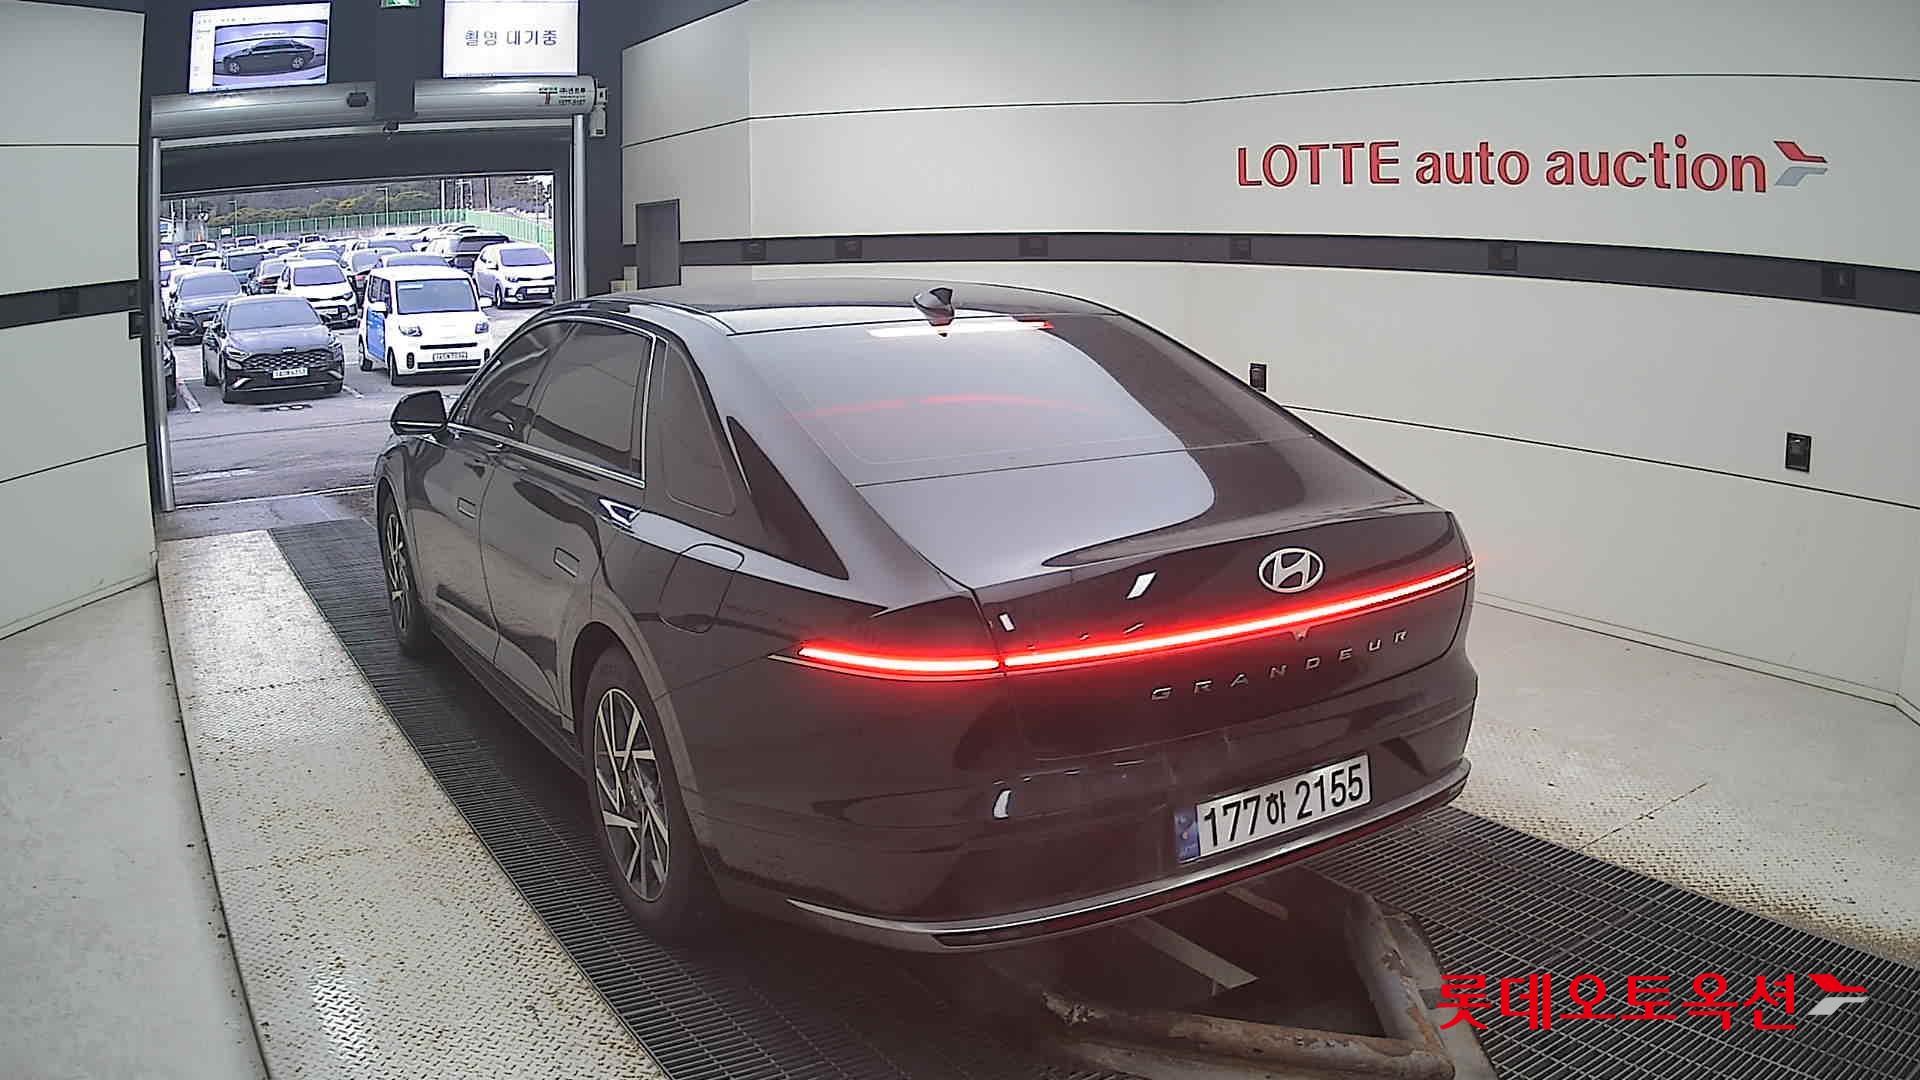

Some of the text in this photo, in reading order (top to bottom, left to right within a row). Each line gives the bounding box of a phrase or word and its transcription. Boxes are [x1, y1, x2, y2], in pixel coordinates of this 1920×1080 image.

[506, 29, 557, 46] 대기중
[1237, 134, 1767, 193] LOTTE auto auction
[1151, 629, 1408, 700] GRANDEUR
[1203, 763, 1364, 847] 177하 2155
